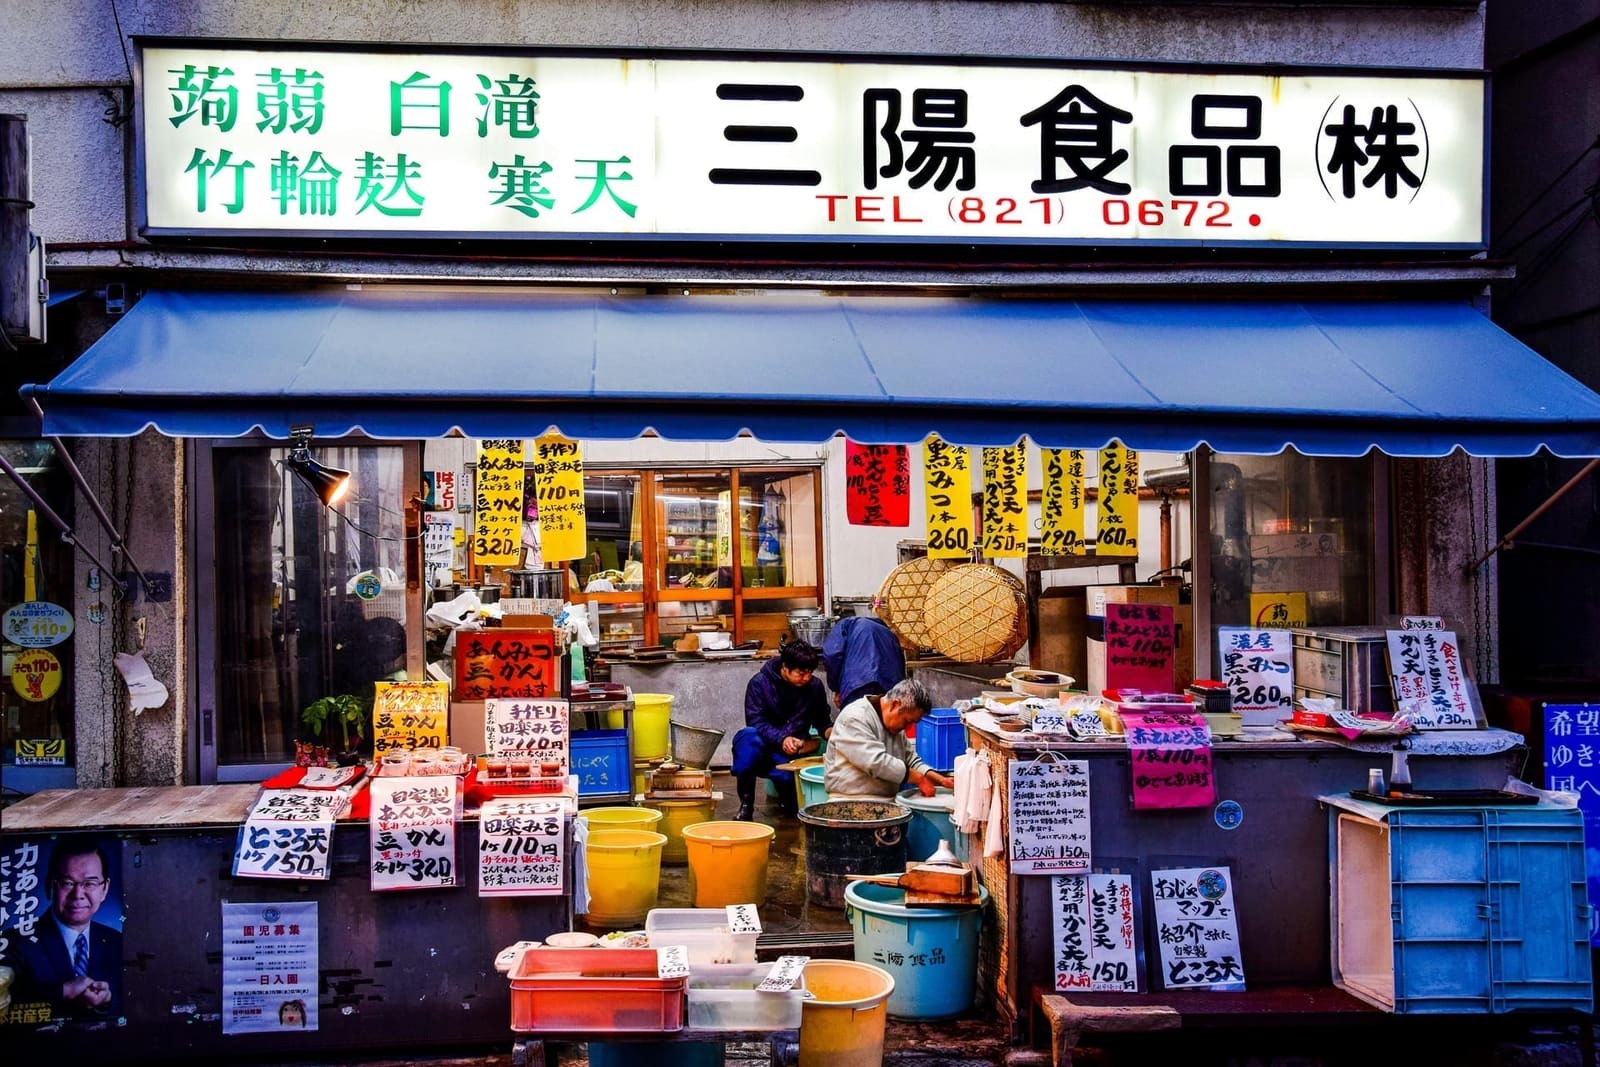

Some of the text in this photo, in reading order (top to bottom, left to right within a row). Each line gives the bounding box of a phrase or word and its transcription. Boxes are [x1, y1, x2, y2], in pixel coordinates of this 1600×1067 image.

[168, 64, 541, 139] 蒟蒻 白滝
[709, 83, 1281, 197] 三陽食品
[489, 154, 638, 219] 寒天
[814, 195, 923, 224] TEL
[947, 196, 1066, 226] (821)
[538, 443, 578, 459] 手作り
[478, 454, 524, 470] あんみつ
[535, 459, 583, 474] 田楽みそ
[925, 438, 955, 507] 黒みつ
[1123, 449, 1138, 495] 自家製
[1002, 449, 1023, 514] ところ天
[1102, 441, 1121, 514] こんにゃく
[539, 486, 580, 500] 110円
[929, 510, 957, 523] 1本
[475, 538, 520, 556] 320円
[927, 528, 974, 554] 260円
[984, 535, 1026, 552] 150円
[1041, 530, 1085, 547] 190円
[1096, 527, 1137, 548] 160円
[465, 641, 552, 662] あんみつ
[1231, 633, 1273, 650] 濃厚
[1224, 653, 1290, 676] 黒みつ
[1400, 635, 1425, 676] かん天
[464, 661, 542, 681] 豆かん
[464, 684, 548, 699] 冷えています
[1233, 686, 1292, 707] 260円
[510, 704, 557, 719] 手作り
[1034, 715, 1065, 727] ところ天
[1437, 714, 1472, 725] 130円
[498, 720, 563, 736] 田楽みそ
[1550, 711, 1600, 736] 希望
[515, 737, 563, 750] 110円
[1551, 744, 1600, 768] ゆき
[391, 786, 452, 804] 自家製
[378, 804, 452, 821] あんみつ
[484, 816, 560, 836] 田楽みそ
[249, 826, 328, 854] ところ天
[375, 828, 446, 851] 豆かん
[502, 836, 557, 856] 110円
[1060, 845, 1090, 858] 150円
[262, 852, 324, 876] 150円
[408, 857, 454, 885] 320円
[14, 843, 39, 943] 力あわせ、
[1106, 880, 1118, 915] 手つき
[1155, 878, 1198, 899] おじゃ
[1092, 888, 1116, 950] ところ天
[1120, 884, 1133, 949] お持ち帰り
[1160, 922, 1232, 944] 紹介された
[245, 974, 298, 985] 一日入園
[1056, 971, 1091, 988] 2人前
[1092, 961, 1135, 990] 150円
[1168, 956, 1243, 984] ところ天
